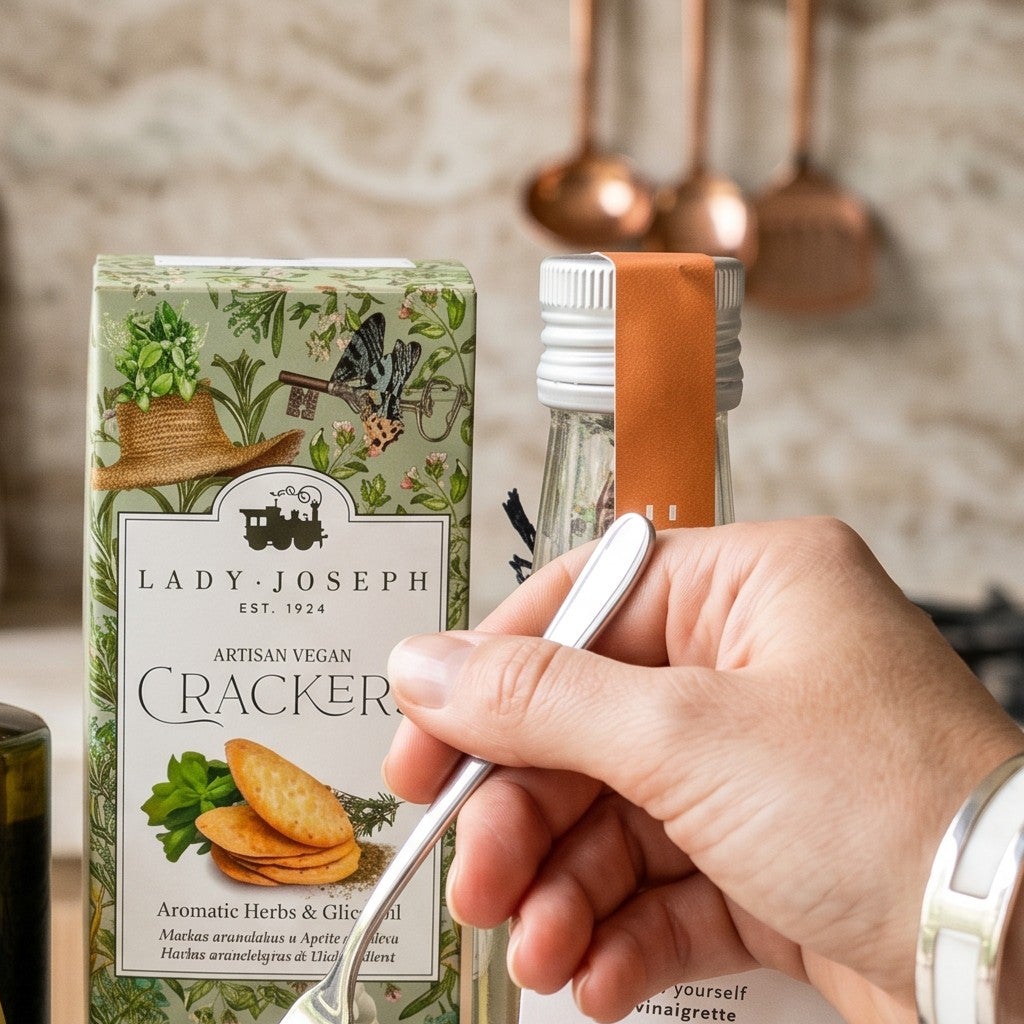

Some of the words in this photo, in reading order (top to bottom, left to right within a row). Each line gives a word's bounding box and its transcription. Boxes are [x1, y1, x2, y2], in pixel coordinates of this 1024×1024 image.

[138, 569, 243, 590] LADY
[272, 570, 428, 593] JOSEPH
[239, 602, 275, 614] EST.
[286, 602, 326, 614] 1924
[213, 647, 287, 663] ARTISAN
[293, 648, 352, 664] VEGAN
[138, 666, 405, 727] CRACKER
[157, 902, 238, 919] Aromatic
[244, 903, 297, 920] Herbs
[302, 904, 318, 920] &
[674, 985, 748, 1000] yourself
[636, 1000, 737, 1022] vinaigrette
